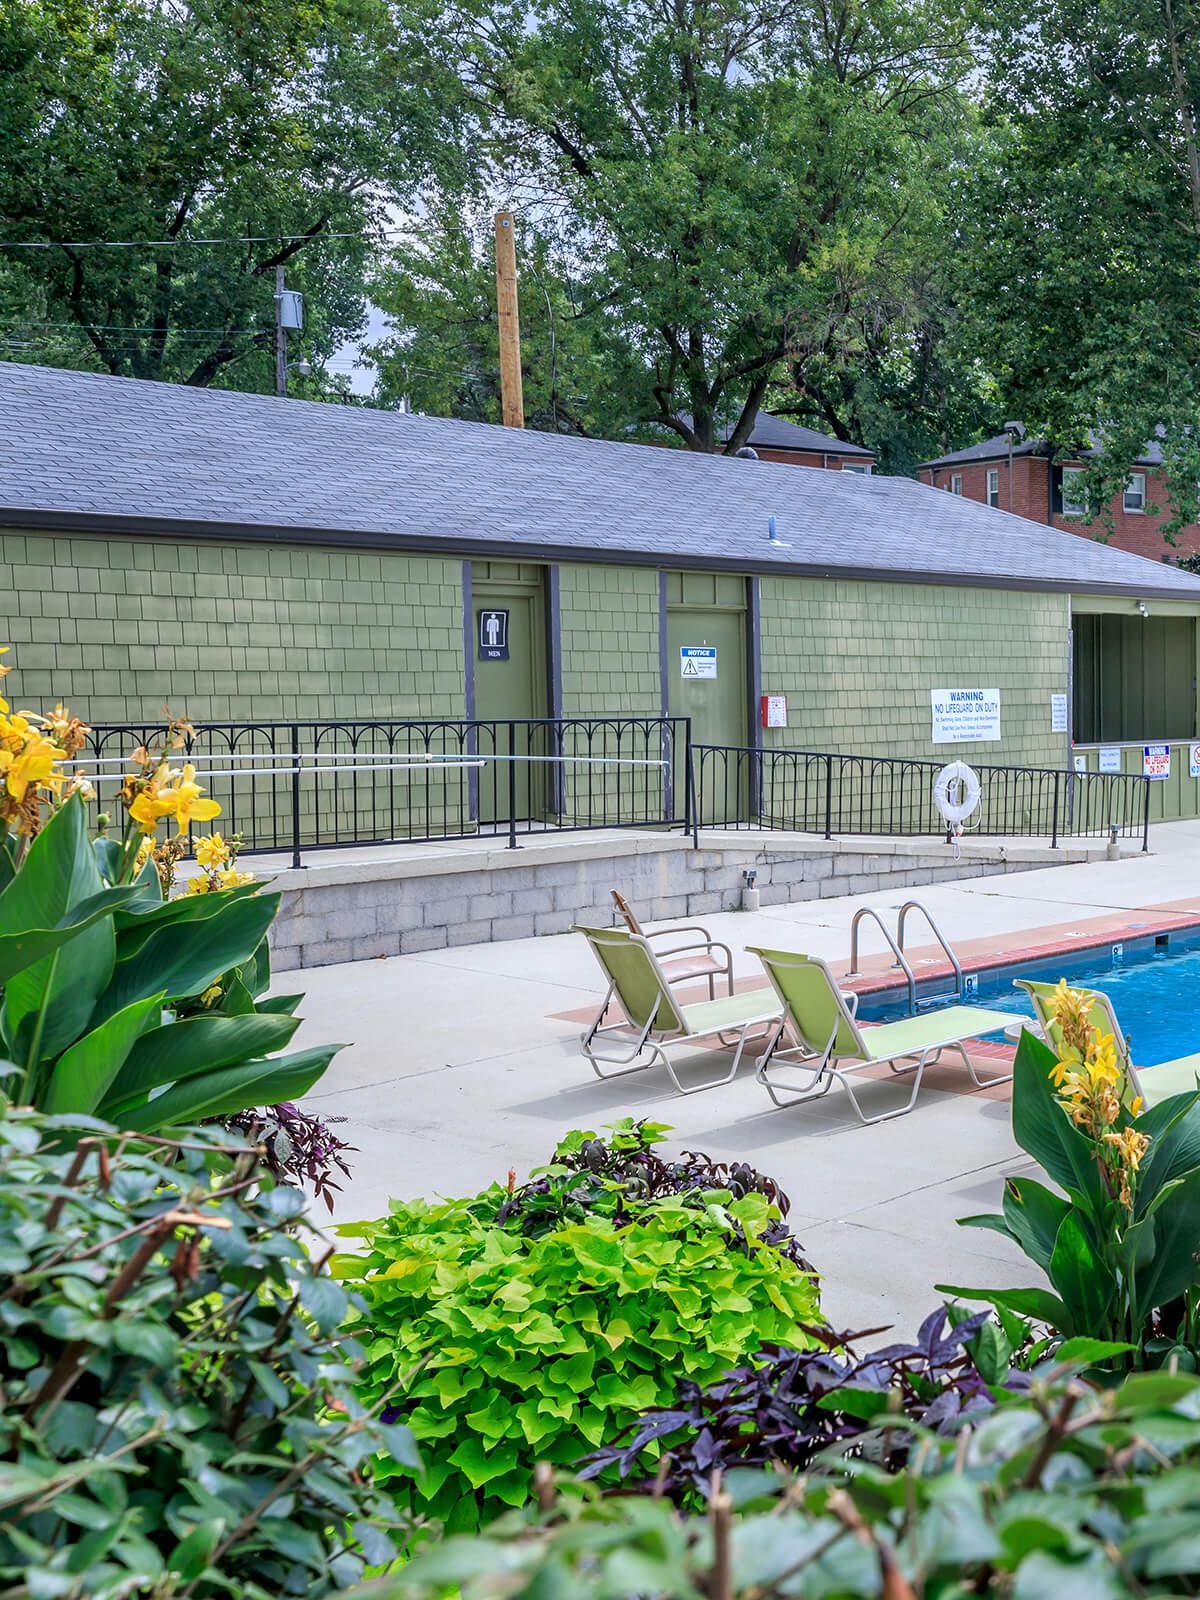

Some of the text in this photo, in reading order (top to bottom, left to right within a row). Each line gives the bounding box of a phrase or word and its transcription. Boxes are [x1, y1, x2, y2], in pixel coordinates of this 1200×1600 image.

[950, 691, 984, 701] WARNING
[935, 702, 998, 714] NO LIFEGUARD ON DUTY
